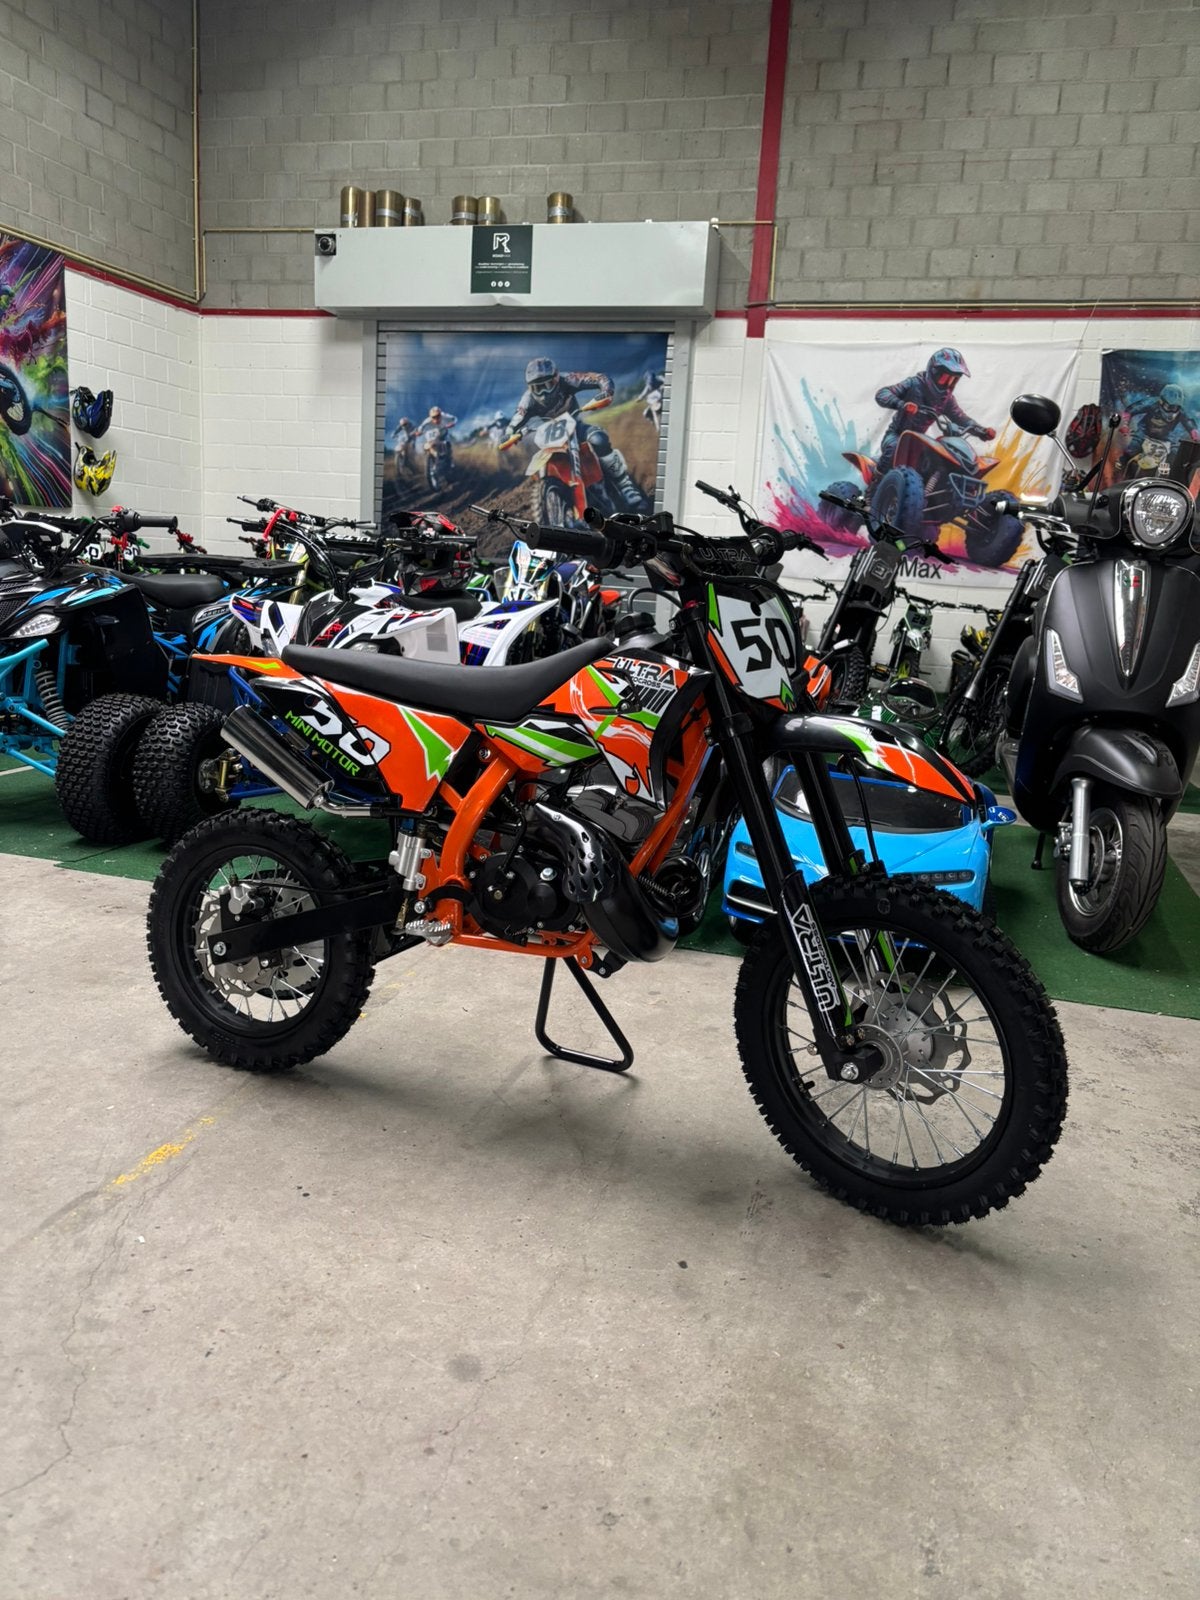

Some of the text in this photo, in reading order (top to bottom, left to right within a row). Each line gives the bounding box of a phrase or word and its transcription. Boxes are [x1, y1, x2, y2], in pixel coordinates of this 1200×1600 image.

[613, 656, 677, 687] ULTRA
[731, 617, 797, 673] 50
[284, 709, 361, 777] MINI MOTOR
[791, 902, 837, 1013] ULTRA
[810, 920, 836, 988] MOTOCROSS
